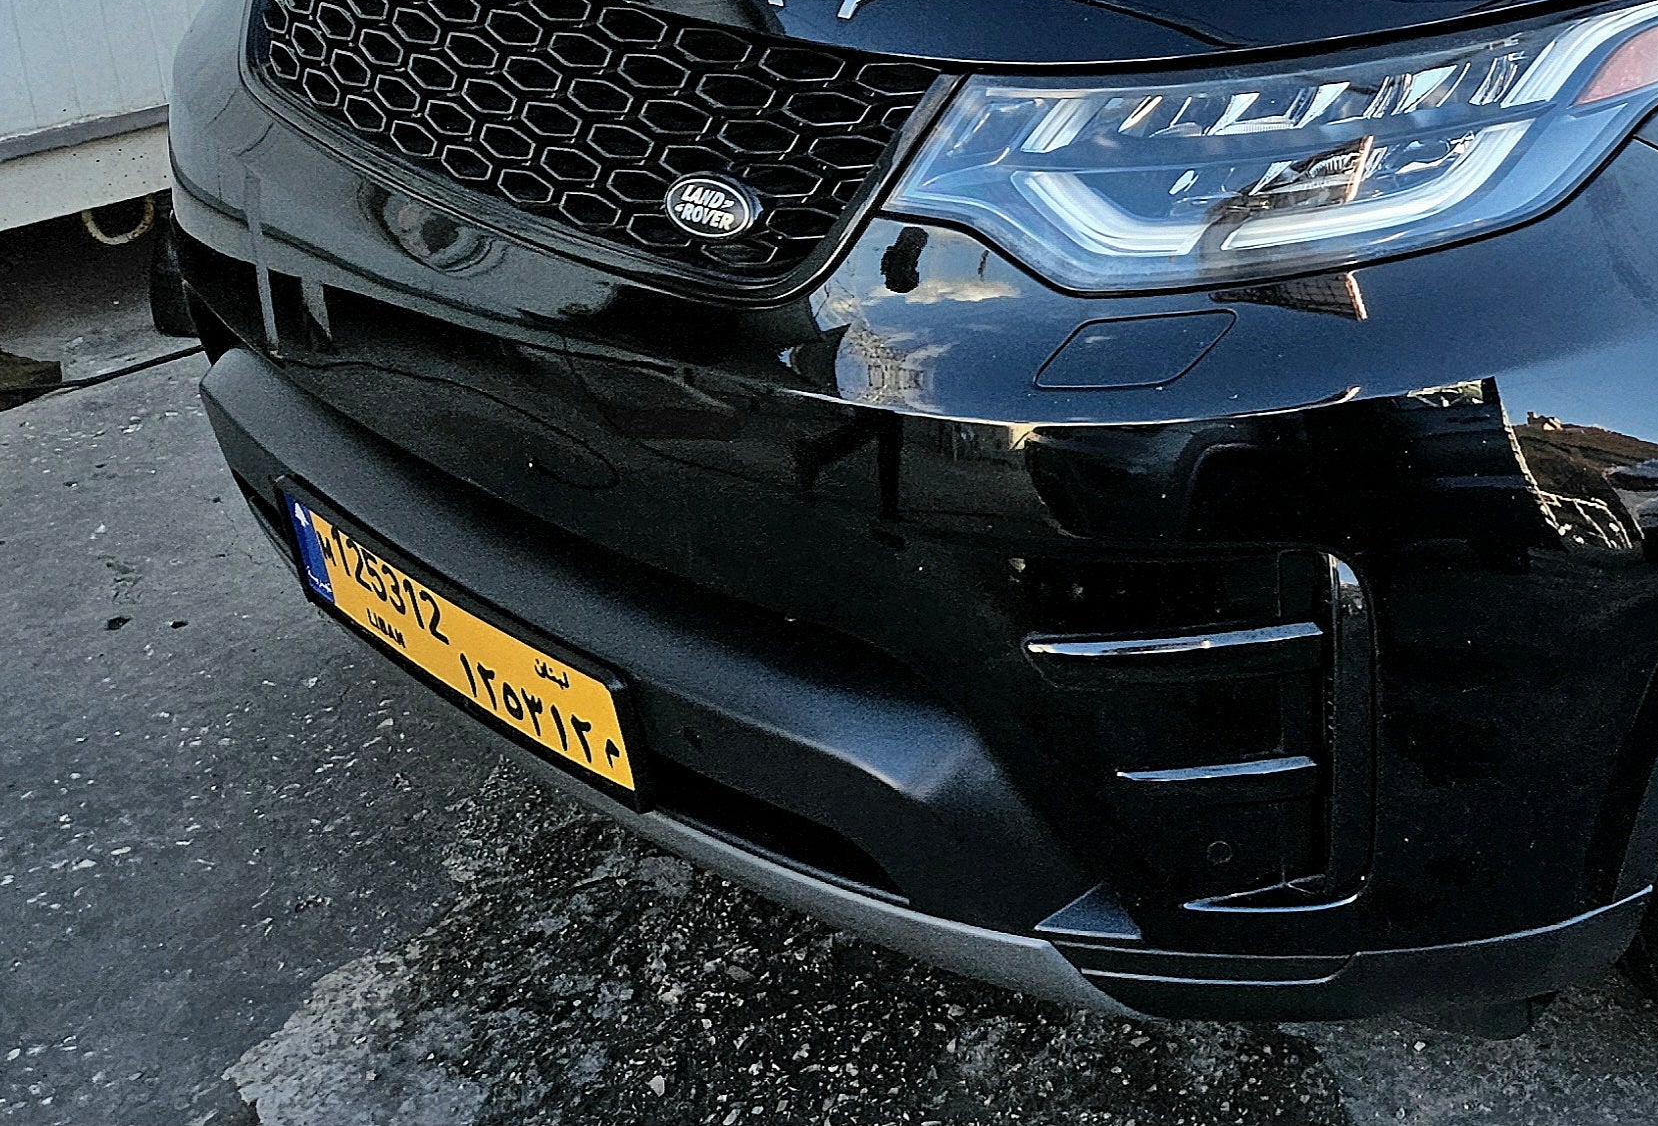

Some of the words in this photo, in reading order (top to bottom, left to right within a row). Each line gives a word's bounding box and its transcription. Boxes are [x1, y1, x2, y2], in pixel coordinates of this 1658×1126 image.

[681, 184, 726, 209] LAND
[680, 202, 735, 231] ROVER
[331, 524, 450, 646] 125312
[366, 607, 407, 649] LIBAN
